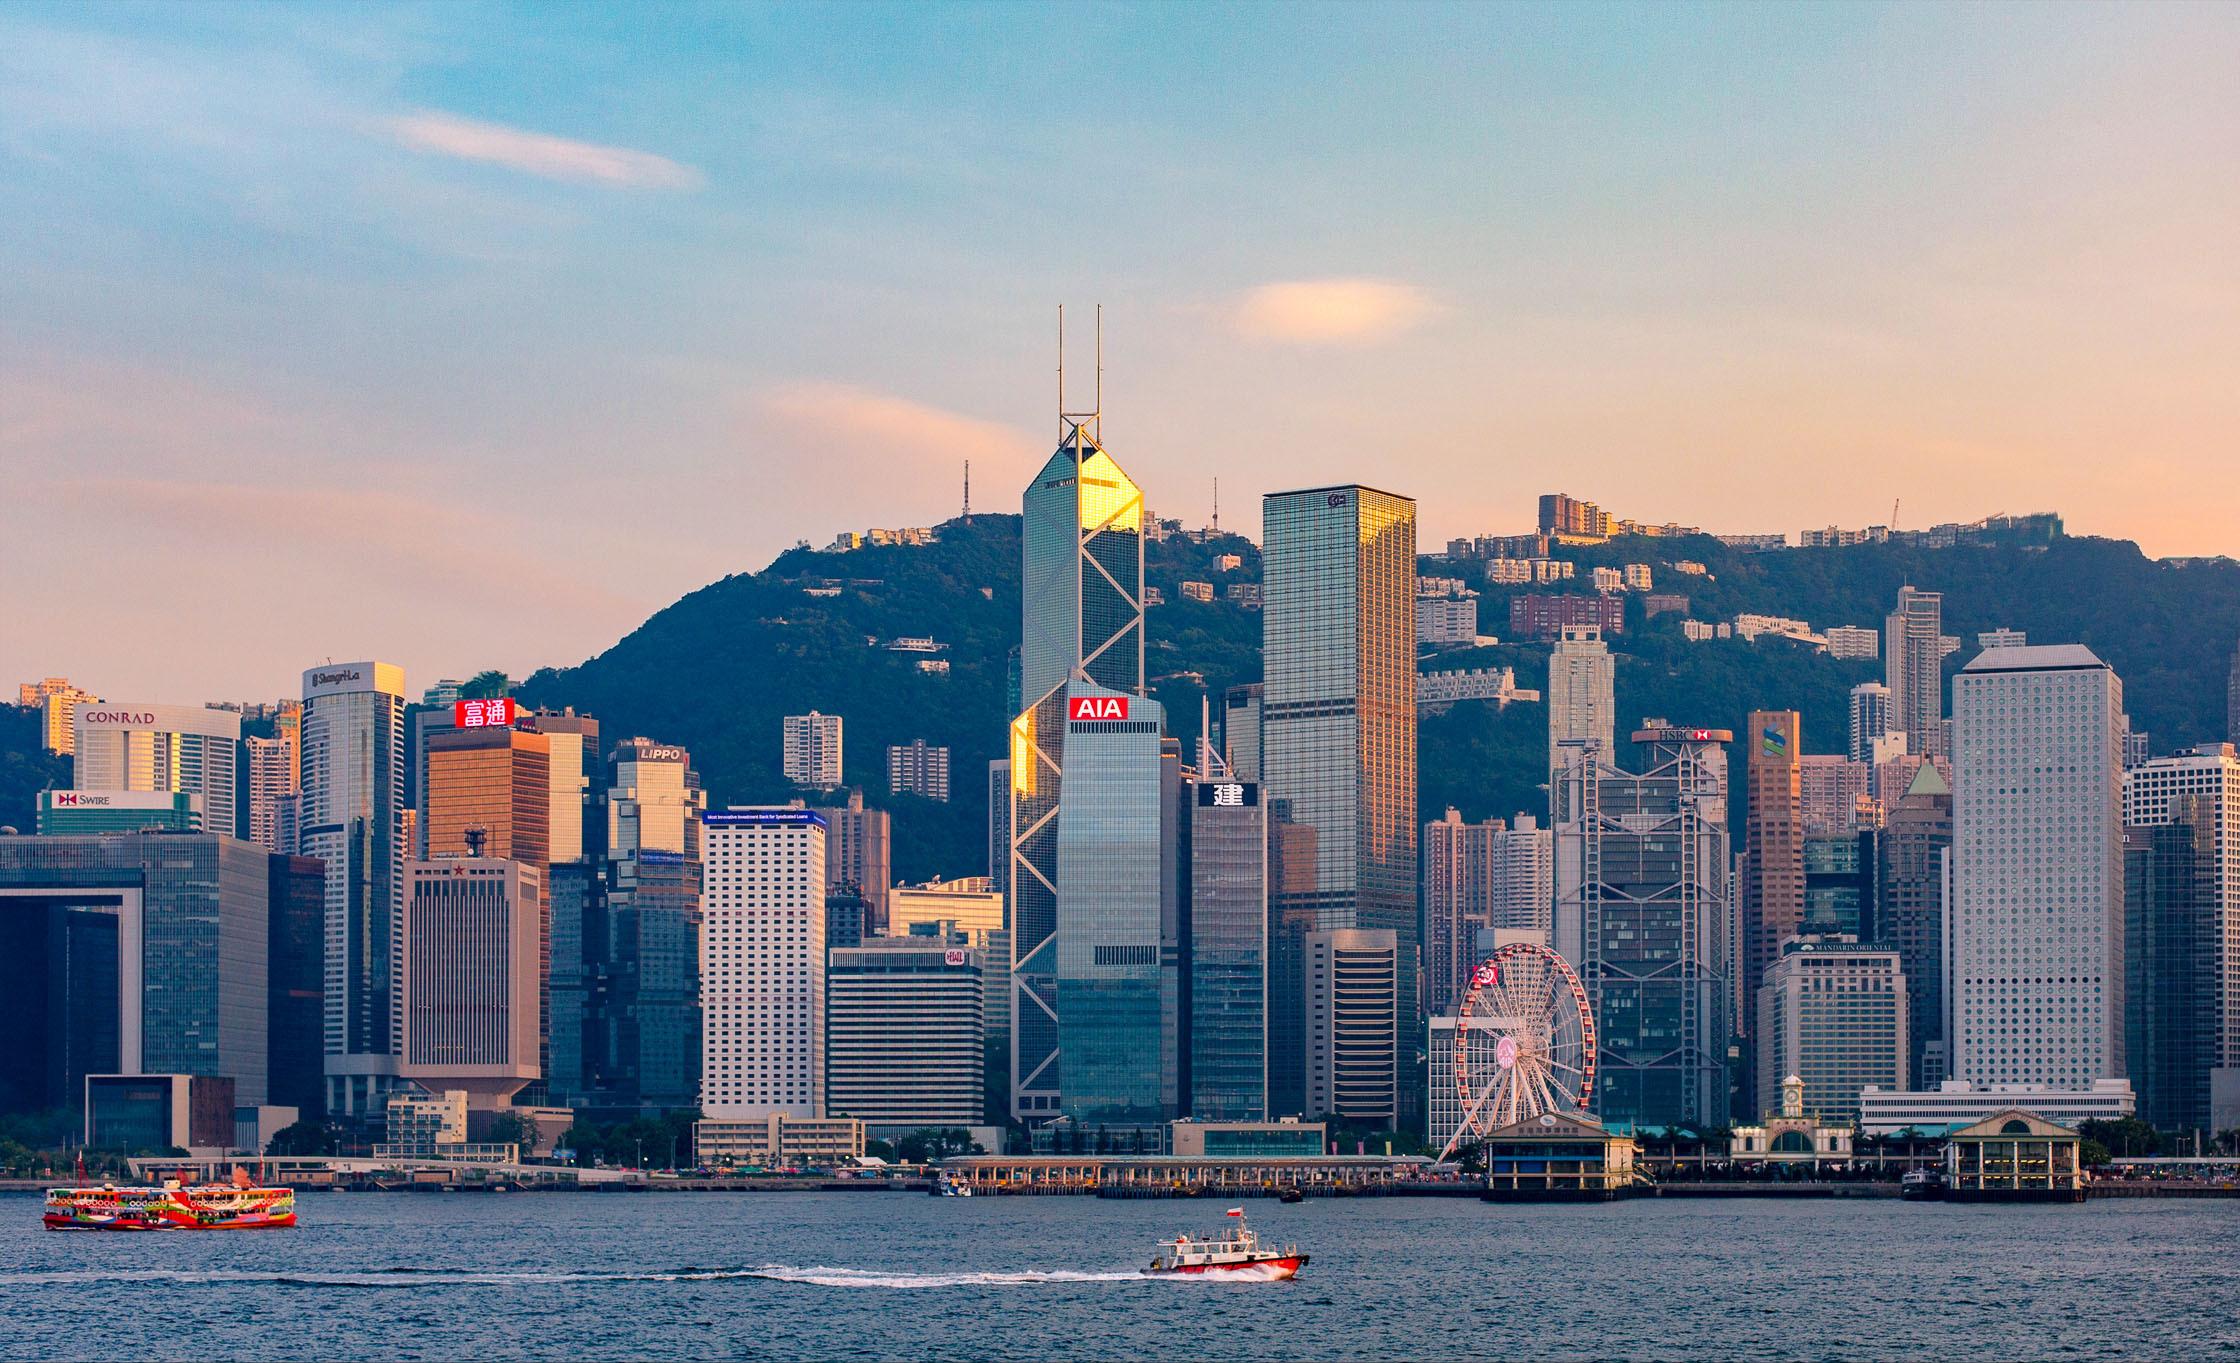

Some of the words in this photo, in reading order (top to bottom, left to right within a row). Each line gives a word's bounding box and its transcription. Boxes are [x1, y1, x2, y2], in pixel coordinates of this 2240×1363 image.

[464, 700, 506, 727] 富通
[1076, 699, 1123, 718] AIA
[86, 711, 155, 724] CONRAD
[1659, 730, 1693, 741] HSBC
[641, 749, 680, 760] LIPPO
[1213, 783, 1244, 806] 建
[1816, 944, 1855, 952] MANDARIN
[1856, 944, 1892, 952] ORIENTAL
